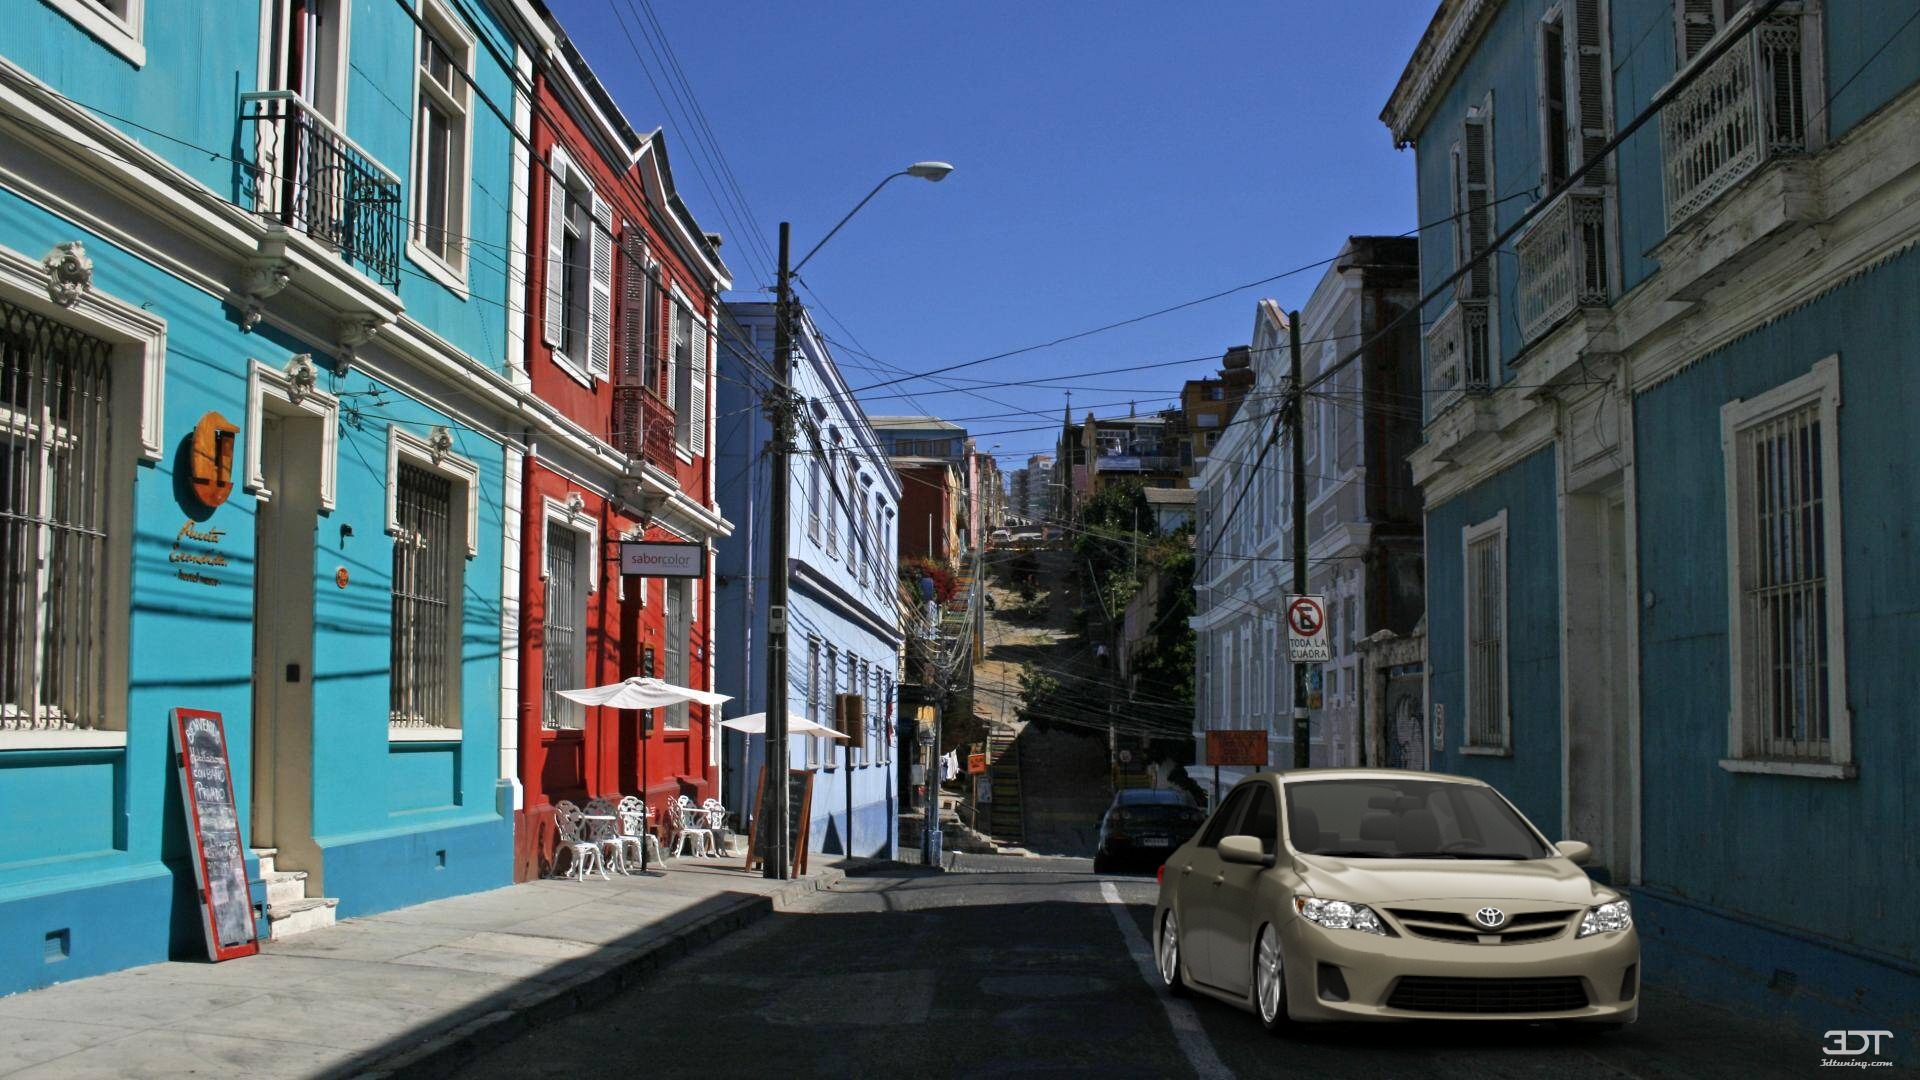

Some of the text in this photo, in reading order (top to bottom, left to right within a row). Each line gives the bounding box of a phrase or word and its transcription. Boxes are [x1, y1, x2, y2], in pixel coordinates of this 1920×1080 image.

[631, 552, 690, 565] saborcolor
[1290, 639, 1327, 648] TODA LA
[1291, 649, 1327, 659] CUADRA
